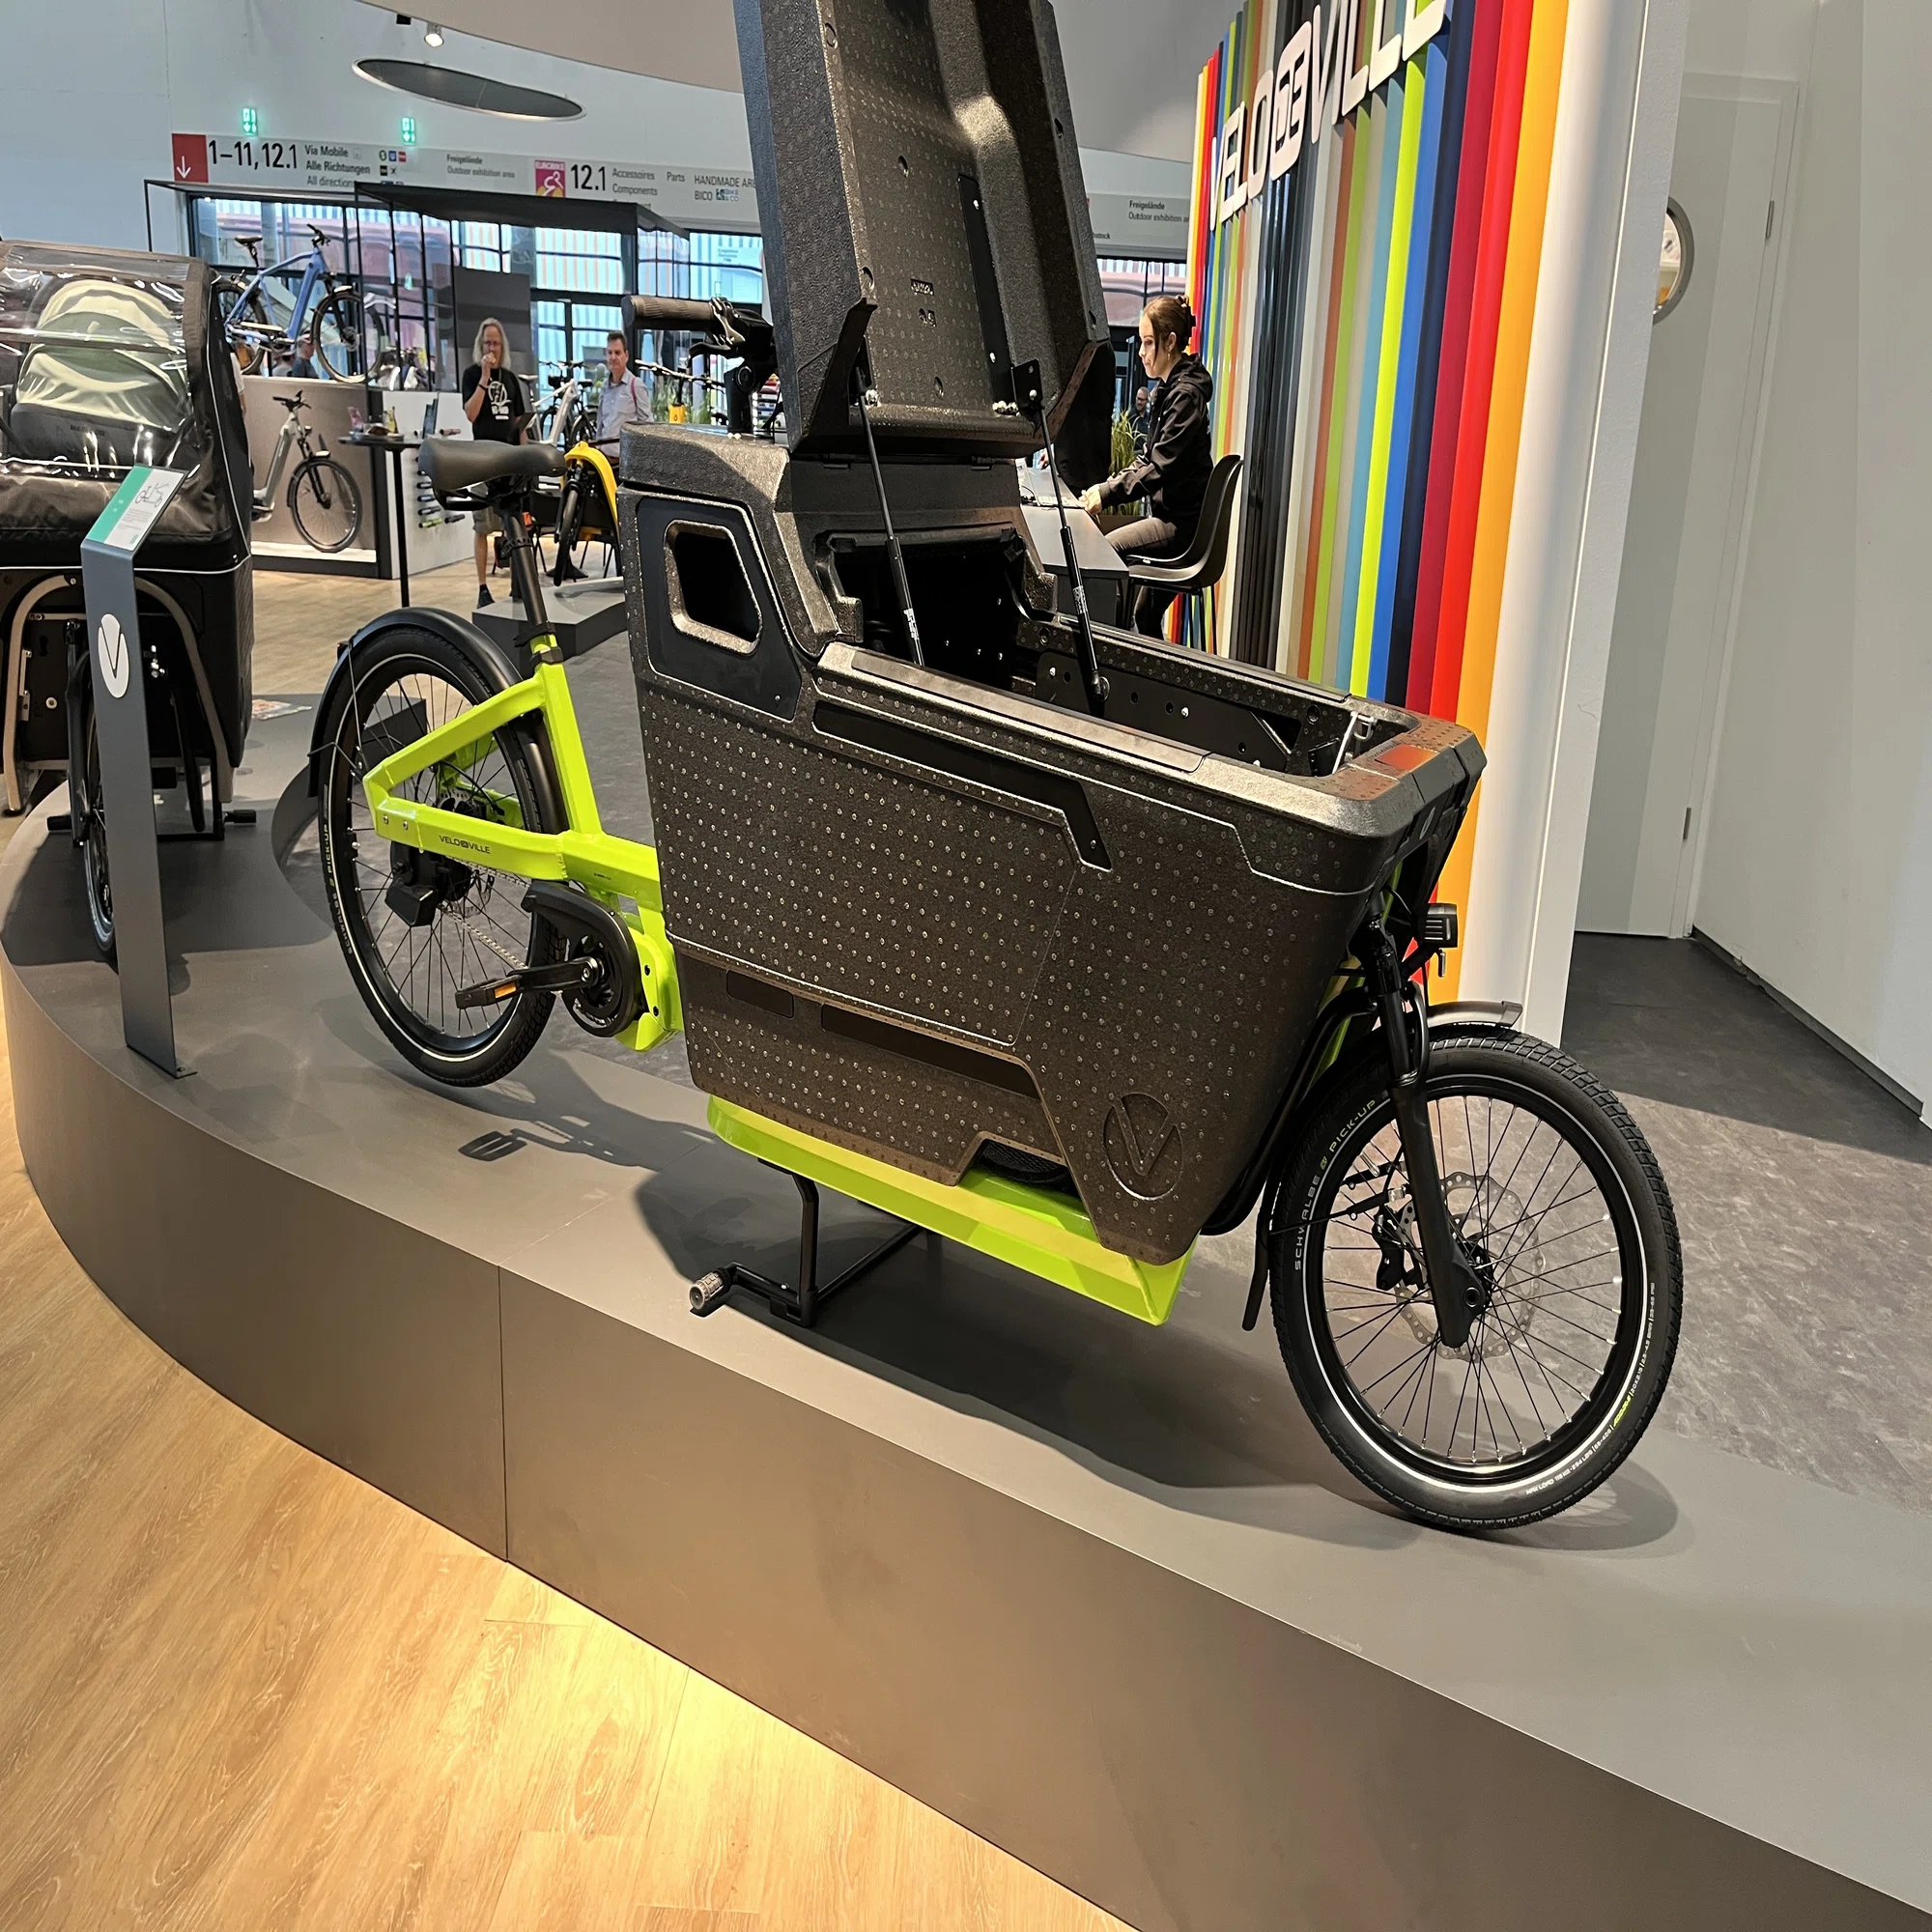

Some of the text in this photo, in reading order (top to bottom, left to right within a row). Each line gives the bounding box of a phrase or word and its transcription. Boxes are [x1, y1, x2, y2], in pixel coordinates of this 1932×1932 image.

[304, 144, 349, 157] Via Mobile
[306, 160, 371, 176] Alle Richtungen
[307, 175, 355, 187] All direction
[571, 164, 606, 191] 12.1
[612, 168, 686, 182] Accessoires Parts
[695, 175, 756, 188] HANDMADE ARE
[612, 183, 658, 195] Components
[695, 190, 713, 201] BICO
[1128, 212, 1153, 221] Outdoor
[1153, 213, 1182, 223] exhibition
[1329, 1099, 1376, 1152] PICK-UP
